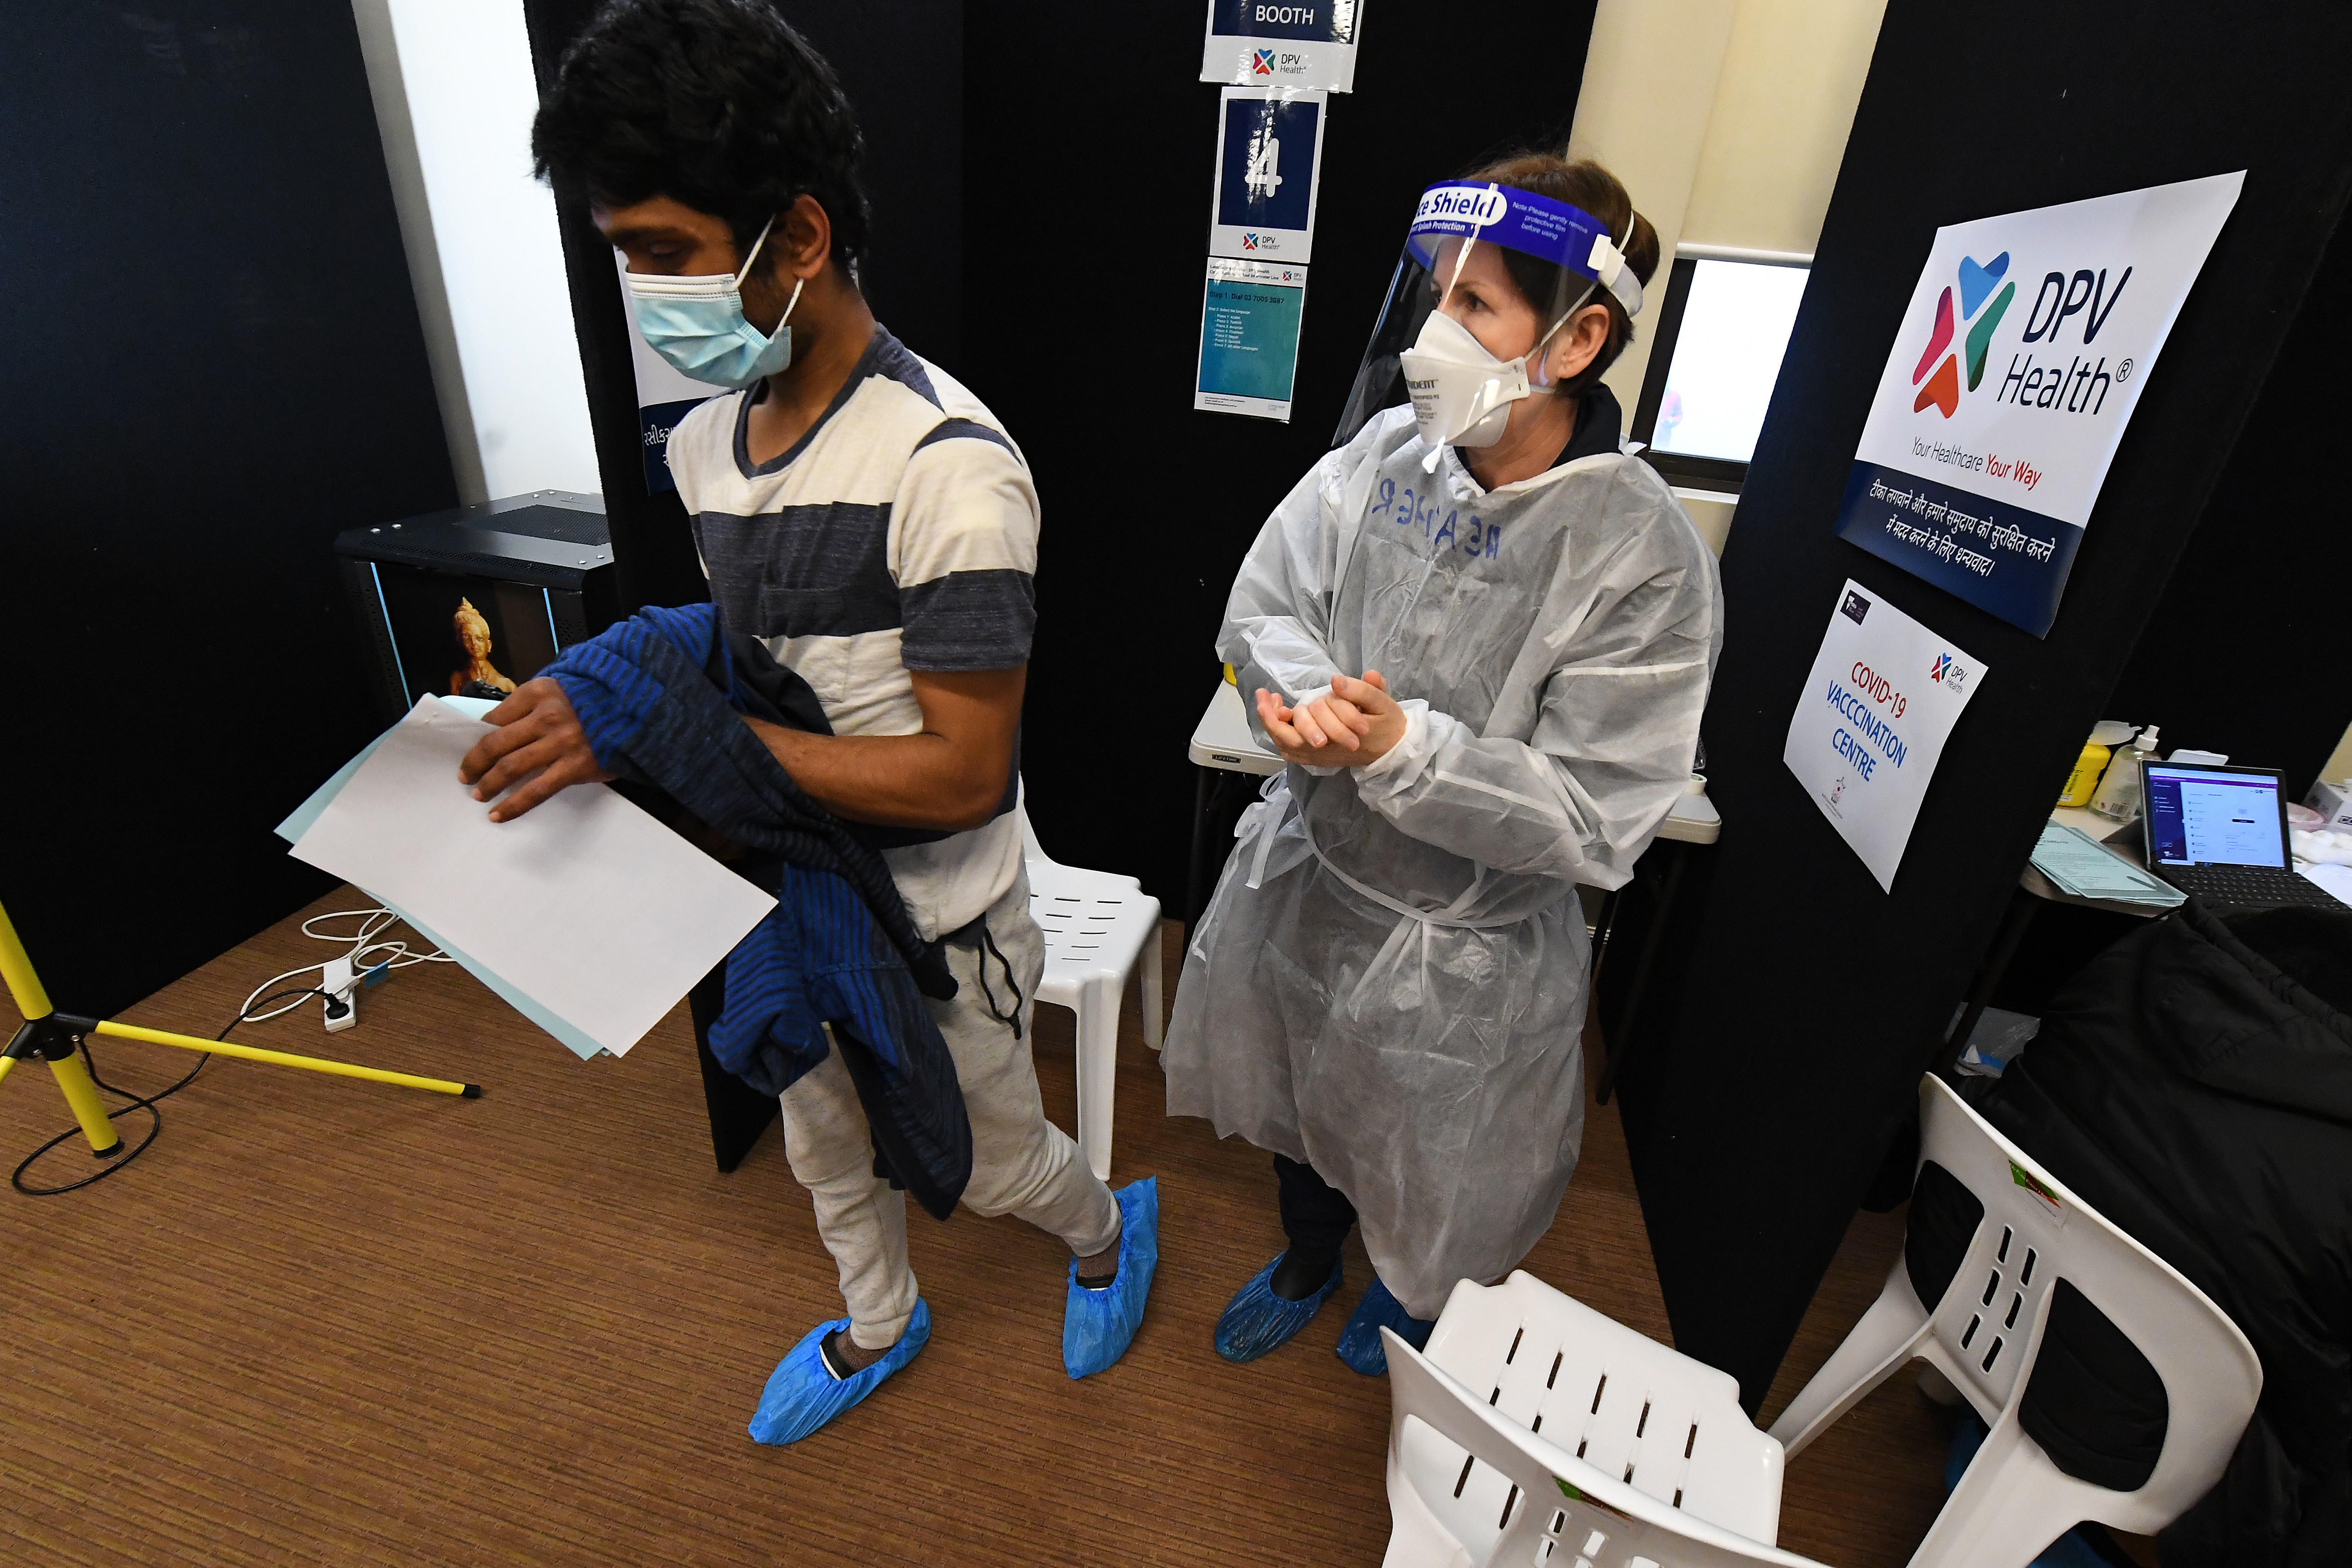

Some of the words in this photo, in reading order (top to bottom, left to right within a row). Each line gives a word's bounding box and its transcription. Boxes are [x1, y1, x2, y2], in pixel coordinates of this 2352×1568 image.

[1255, 5, 1314, 25] BOOTH
[1281, 54, 1301, 65] DPV
[1245, 138, 1283, 197] 4
[1431, 192, 1497, 218] Shield
[1432, 220, 1465, 231] Protection
[2022, 266, 2132, 345] DPV
[1912, 436, 1931, 457] Your
[1930, 441, 1983, 471] Healthcare
[1986, 453, 2012, 478] Your
[2013, 460, 2042, 491] Way
[1870, 478, 1888, 500] टीका
[1886, 489, 1913, 509] लगवाने
[1911, 493, 1928, 515] और
[1925, 501, 1948, 523] हमारे
[1947, 509, 1978, 534] समुदाय
[1977, 516, 1993, 539] को
[1990, 524, 2029, 553] सुरक्षित
[2026, 537, 2055, 563] करने
[1886, 513, 1898, 533] में
[1893, 521, 1912, 541] मदद
[1908, 527, 1931, 547] करने
[1927, 530, 1940, 551] के
[1935, 534, 1958, 564] लिए
[1851, 661, 1906, 719] COVID-19
[1946, 677, 1963, 694] Health
[1951, 666, 1968, 682] DPV
[1827, 680, 1907, 768] VACCCINATION
[1832, 728, 1876, 782] CENTRE
